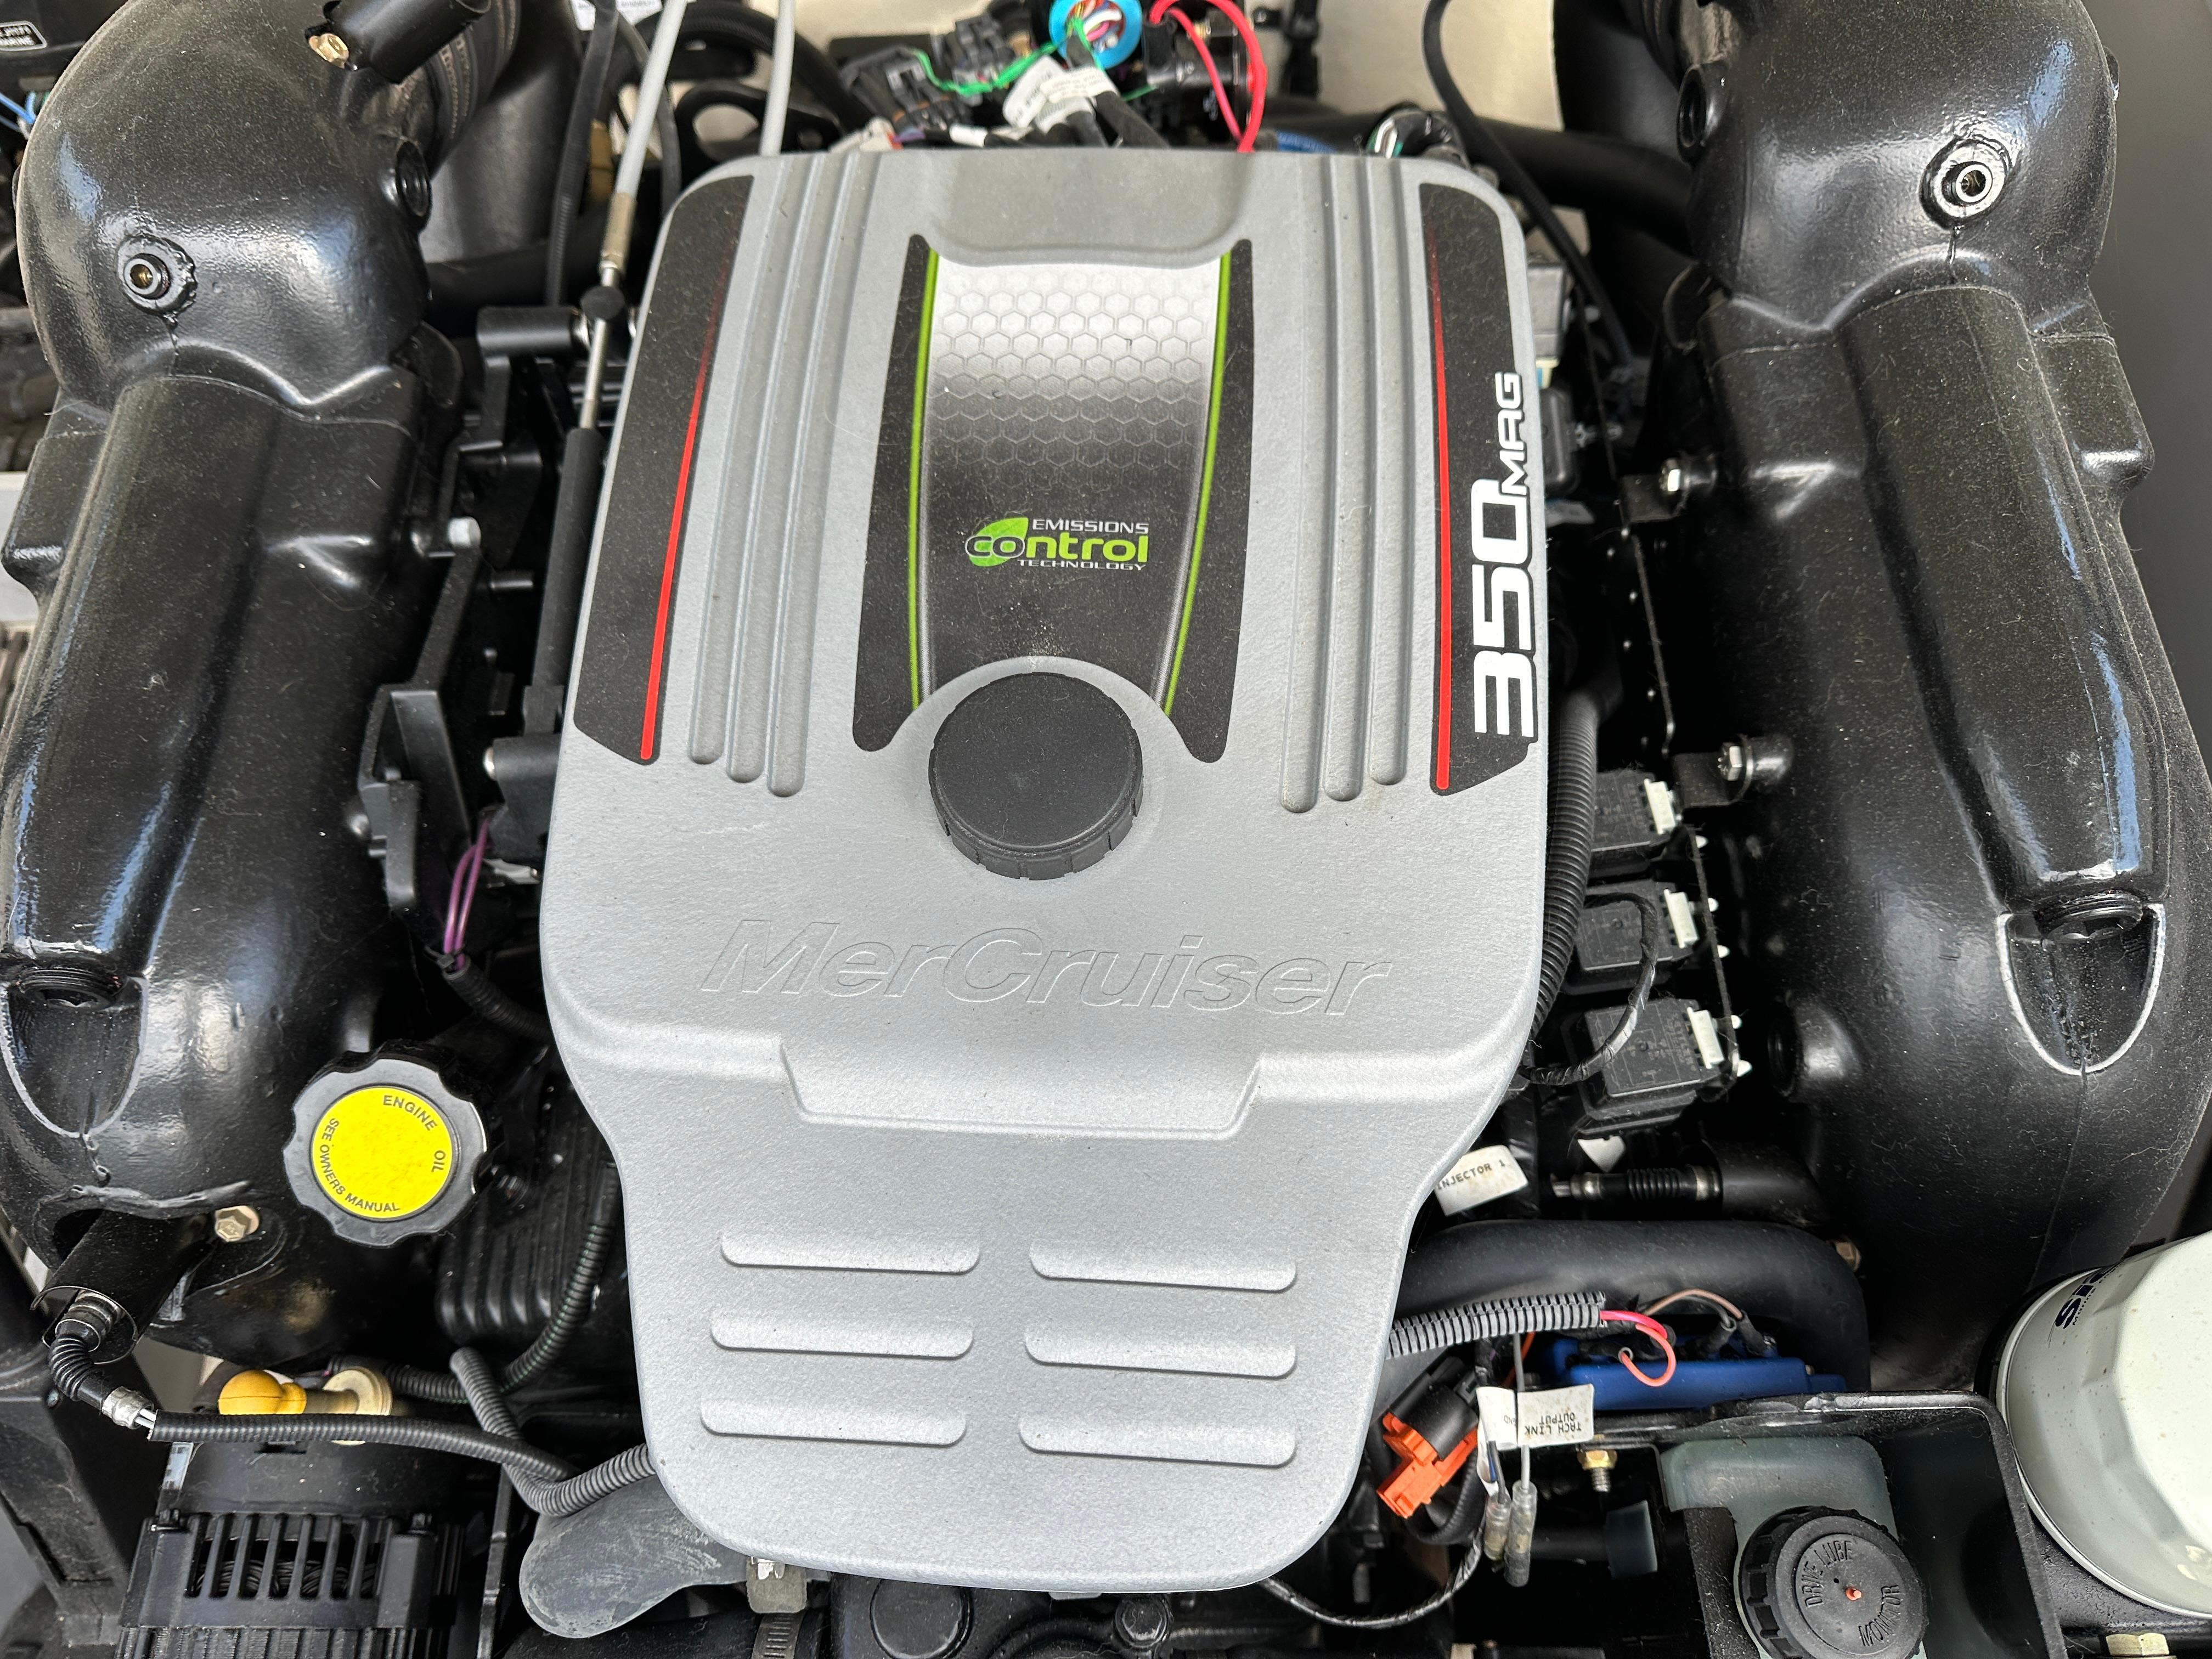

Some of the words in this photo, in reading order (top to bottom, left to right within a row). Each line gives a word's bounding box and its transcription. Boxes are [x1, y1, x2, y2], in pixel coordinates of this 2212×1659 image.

[1494, 372, 1527, 495] MAG
[1032, 518, 1149, 534] EMISSIONS
[964, 532, 1149, 563] control
[1017, 559, 1147, 571] TECHNOLOGY
[1471, 478, 1534, 738] 350
[698, 919, 1394, 1017] MerCruiser
[321, 1118, 340, 1142] SEE
[383, 1094, 437, 1131] ENGINE
[431, 1150, 446, 1173] OIL
[319, 1144, 346, 1195] OWNERS
[1437, 1163, 1492, 1190] INJECTOR
[1498, 1158, 1505, 1167] 1
[345, 1192, 400, 1212] MANUAL
[1524, 1425, 1551, 1435] LINK
[1539, 1412, 1575, 1425] OUTPUT
[1558, 1421, 1582, 1433] TACH
[1801, 1560, 1824, 1607] DRIVE
[1814, 1540, 1853, 1568] LUBE
[1858, 1584, 1901, 1646] MONITOR
